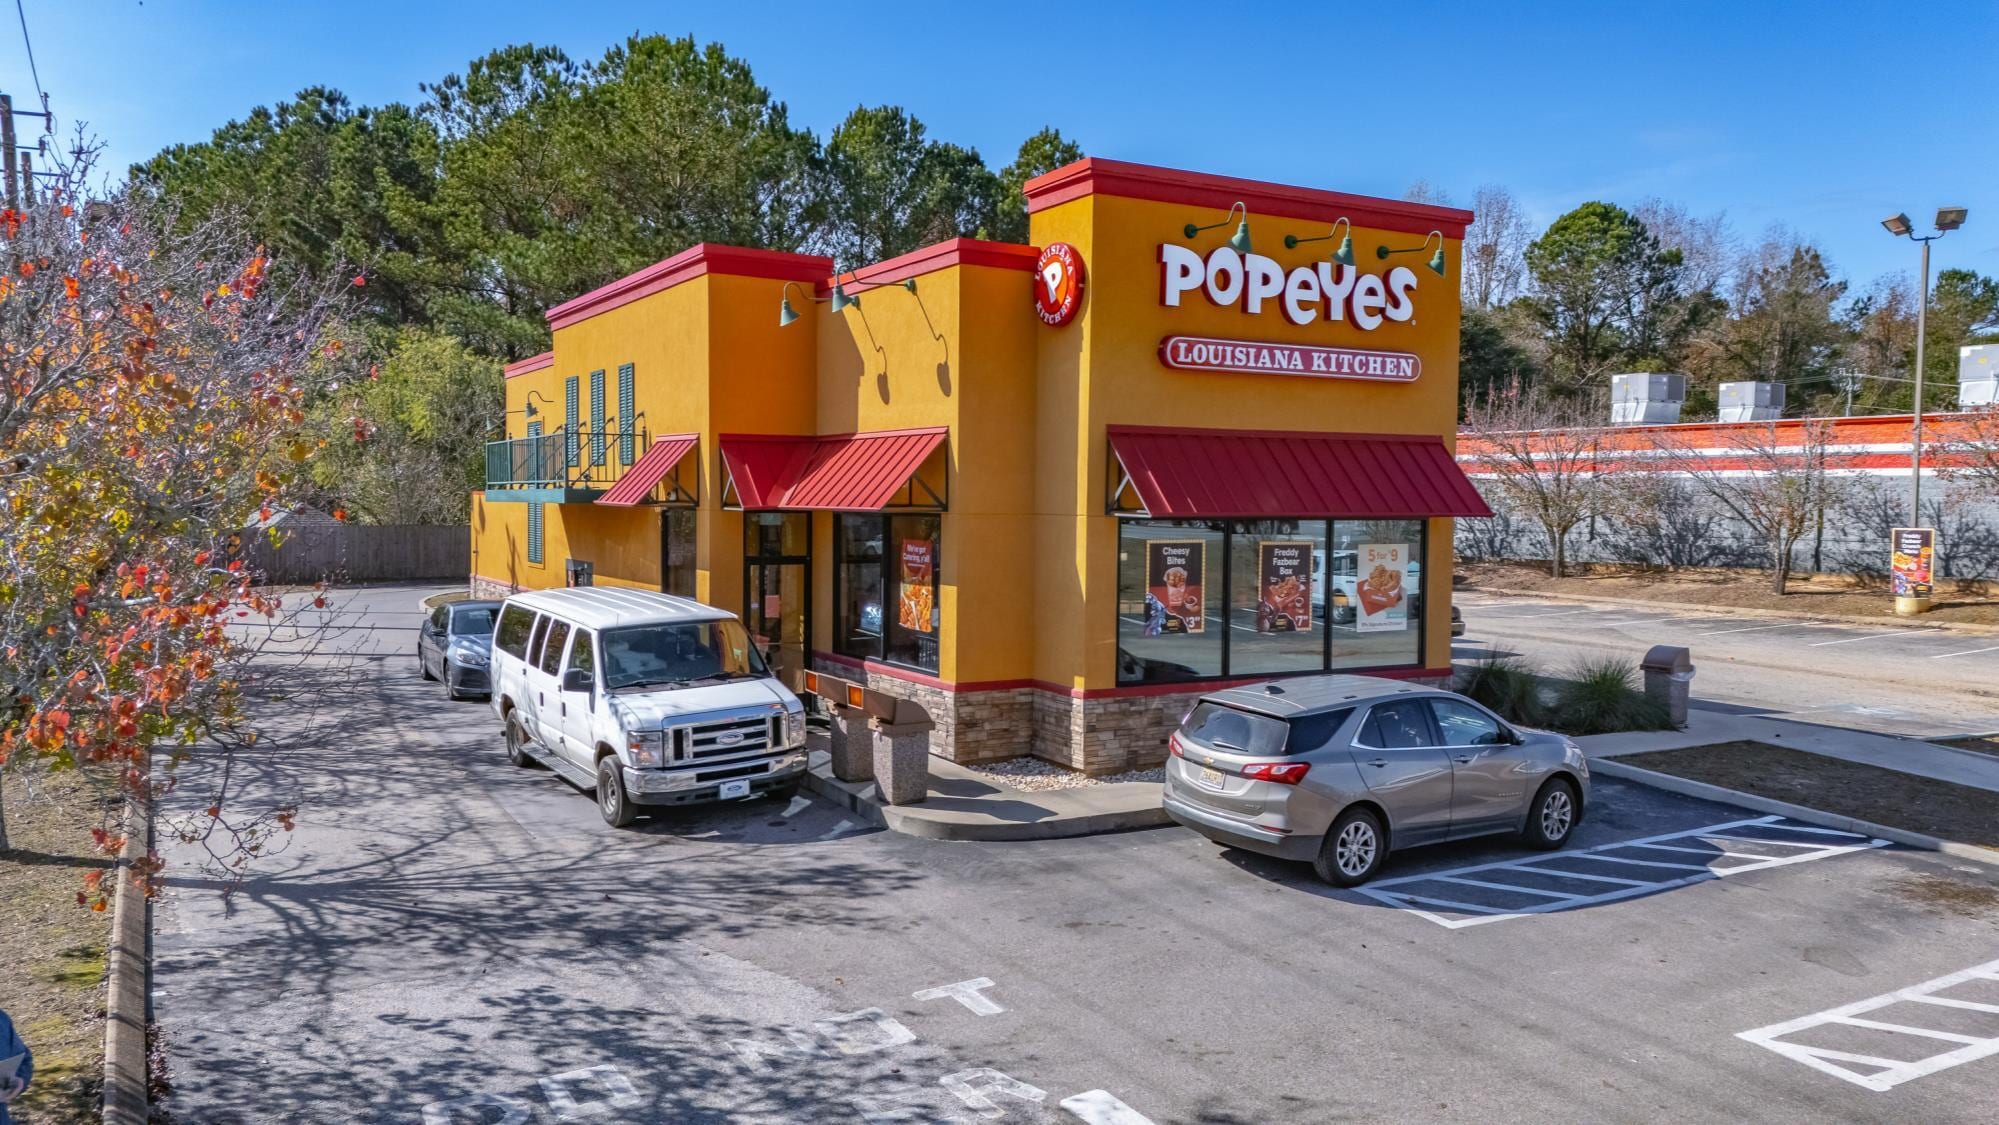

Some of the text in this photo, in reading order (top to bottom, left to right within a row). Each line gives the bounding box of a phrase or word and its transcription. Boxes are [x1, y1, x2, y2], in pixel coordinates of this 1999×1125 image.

[1177, 342, 1414, 377] LOUISIANA KITCHEN
[1162, 546, 1190, 556] Cheesy
[1273, 548, 1299, 557] Freddy
[1368, 548, 1376, 562] 5
[1376, 551, 1387, 560] for
[1166, 556, 1186, 565] Bites
[1272, 557, 1300, 566] Fazbear
[1279, 566, 1293, 575] Box
